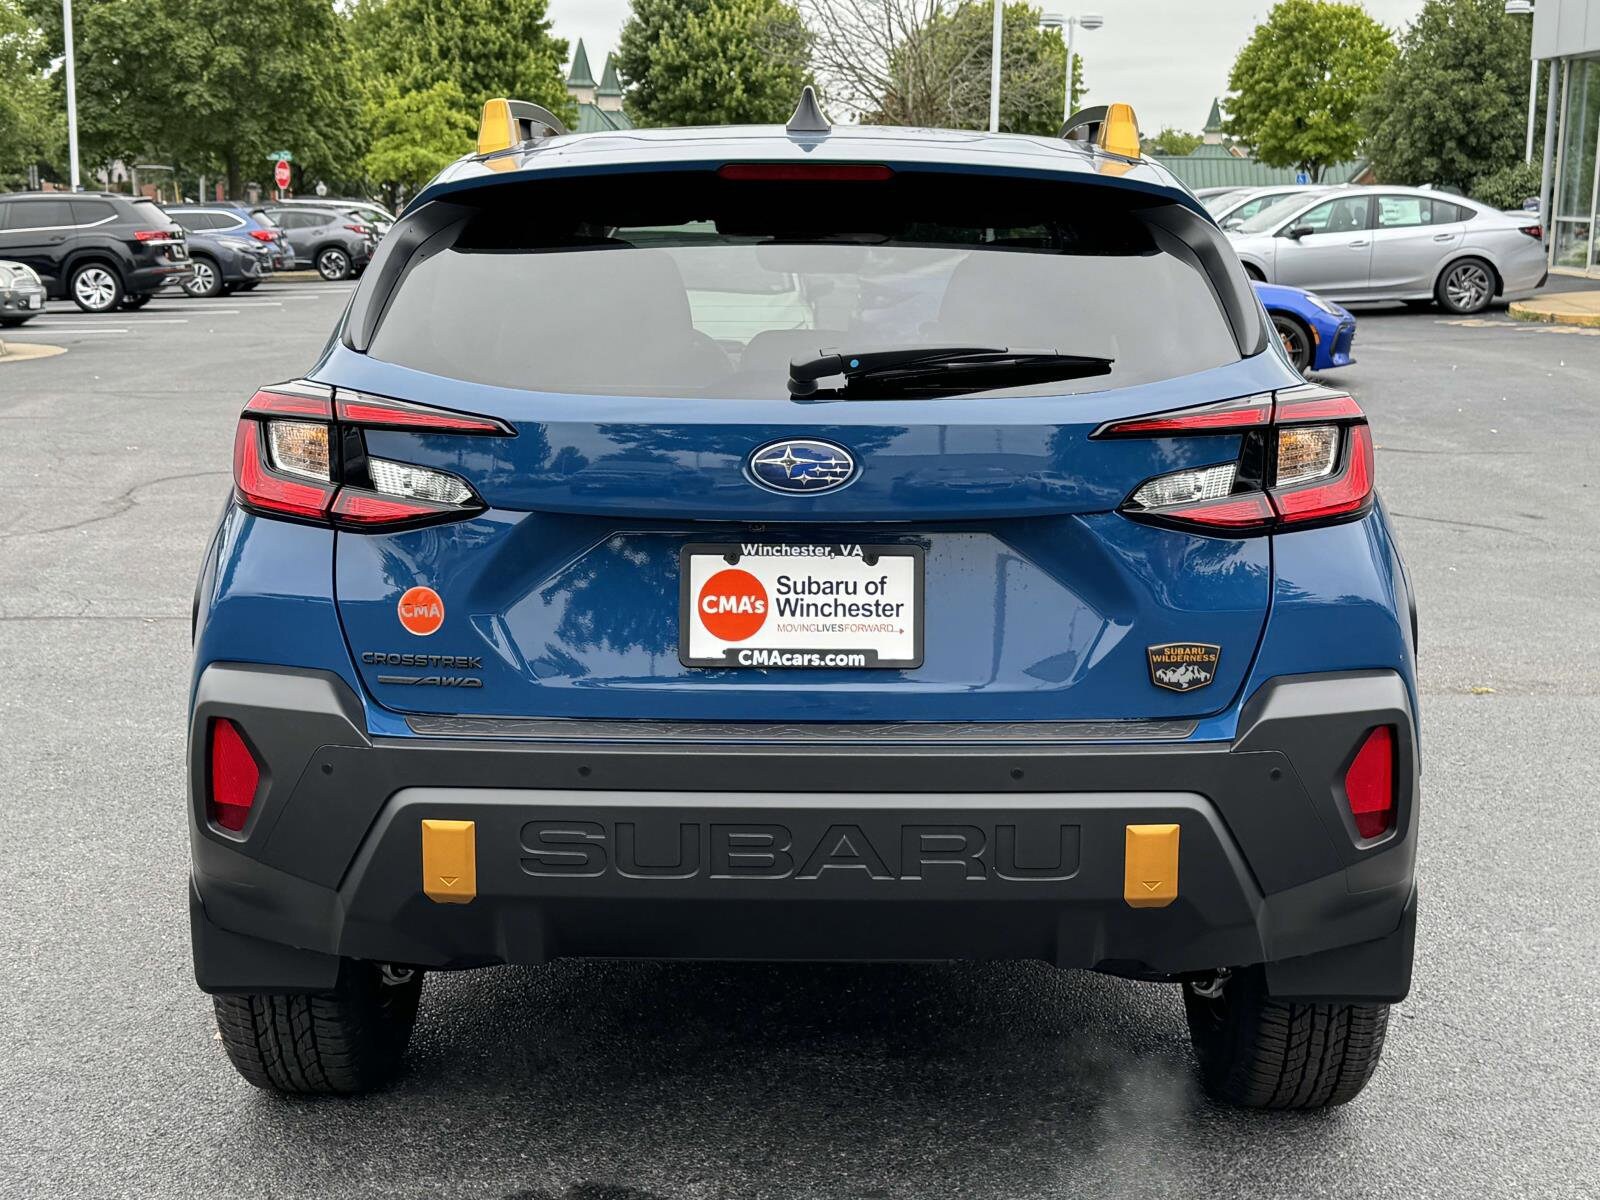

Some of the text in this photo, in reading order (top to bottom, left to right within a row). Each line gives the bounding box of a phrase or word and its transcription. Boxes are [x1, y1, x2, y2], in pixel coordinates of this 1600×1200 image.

[741, 544, 864, 559] Winchester, VA
[776, 576, 888, 596] Subaru of
[401, 604, 441, 618] CMA
[701, 595, 765, 614] CMA's
[776, 598, 904, 618] Winchester
[738, 650, 865, 667] CMAcars.com
[1152, 654, 1217, 663] WILDERNESS
[1164, 647, 1205, 655] SUBARU
[361, 651, 484, 669] CROSSTREK
[415, 676, 483, 688] AWD
[519, 820, 1081, 882] SUBARU
